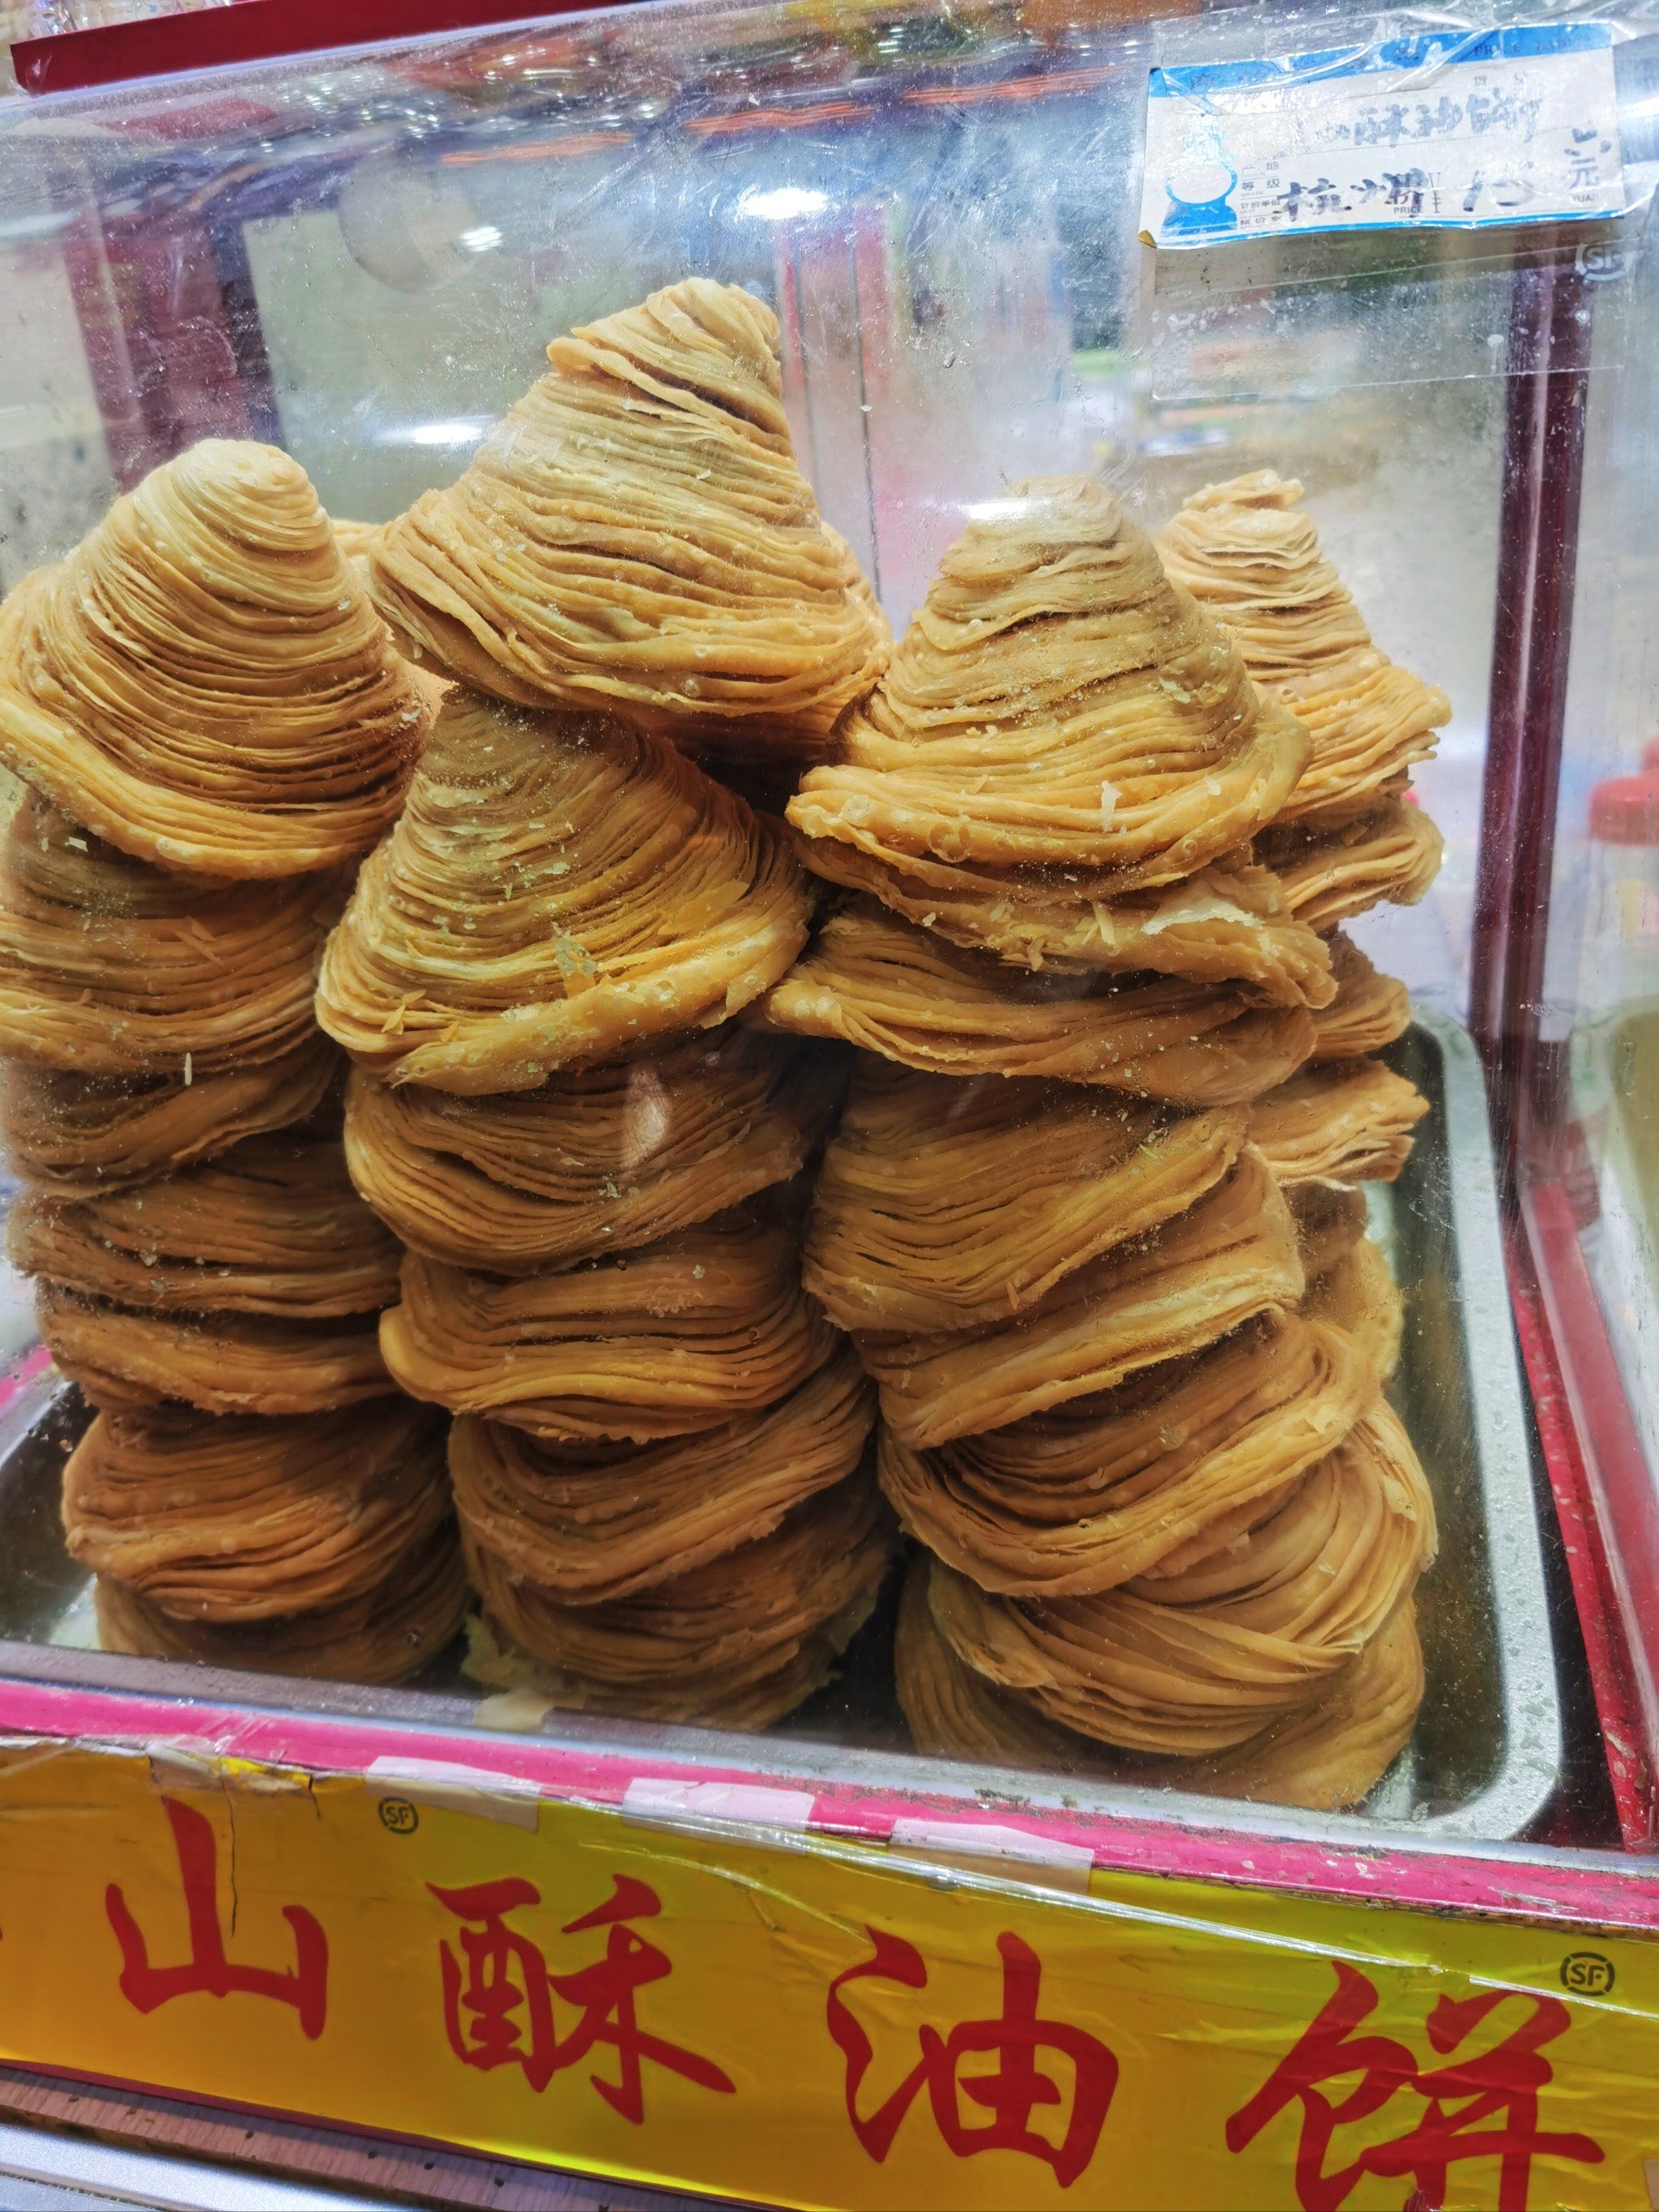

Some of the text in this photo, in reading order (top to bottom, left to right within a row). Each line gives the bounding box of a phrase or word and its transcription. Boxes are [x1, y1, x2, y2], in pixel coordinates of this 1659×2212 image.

[1569, 157, 1599, 190] 元
[1241, 178, 1281, 192] 等级
[1393, 206, 1423, 214] PRICE
